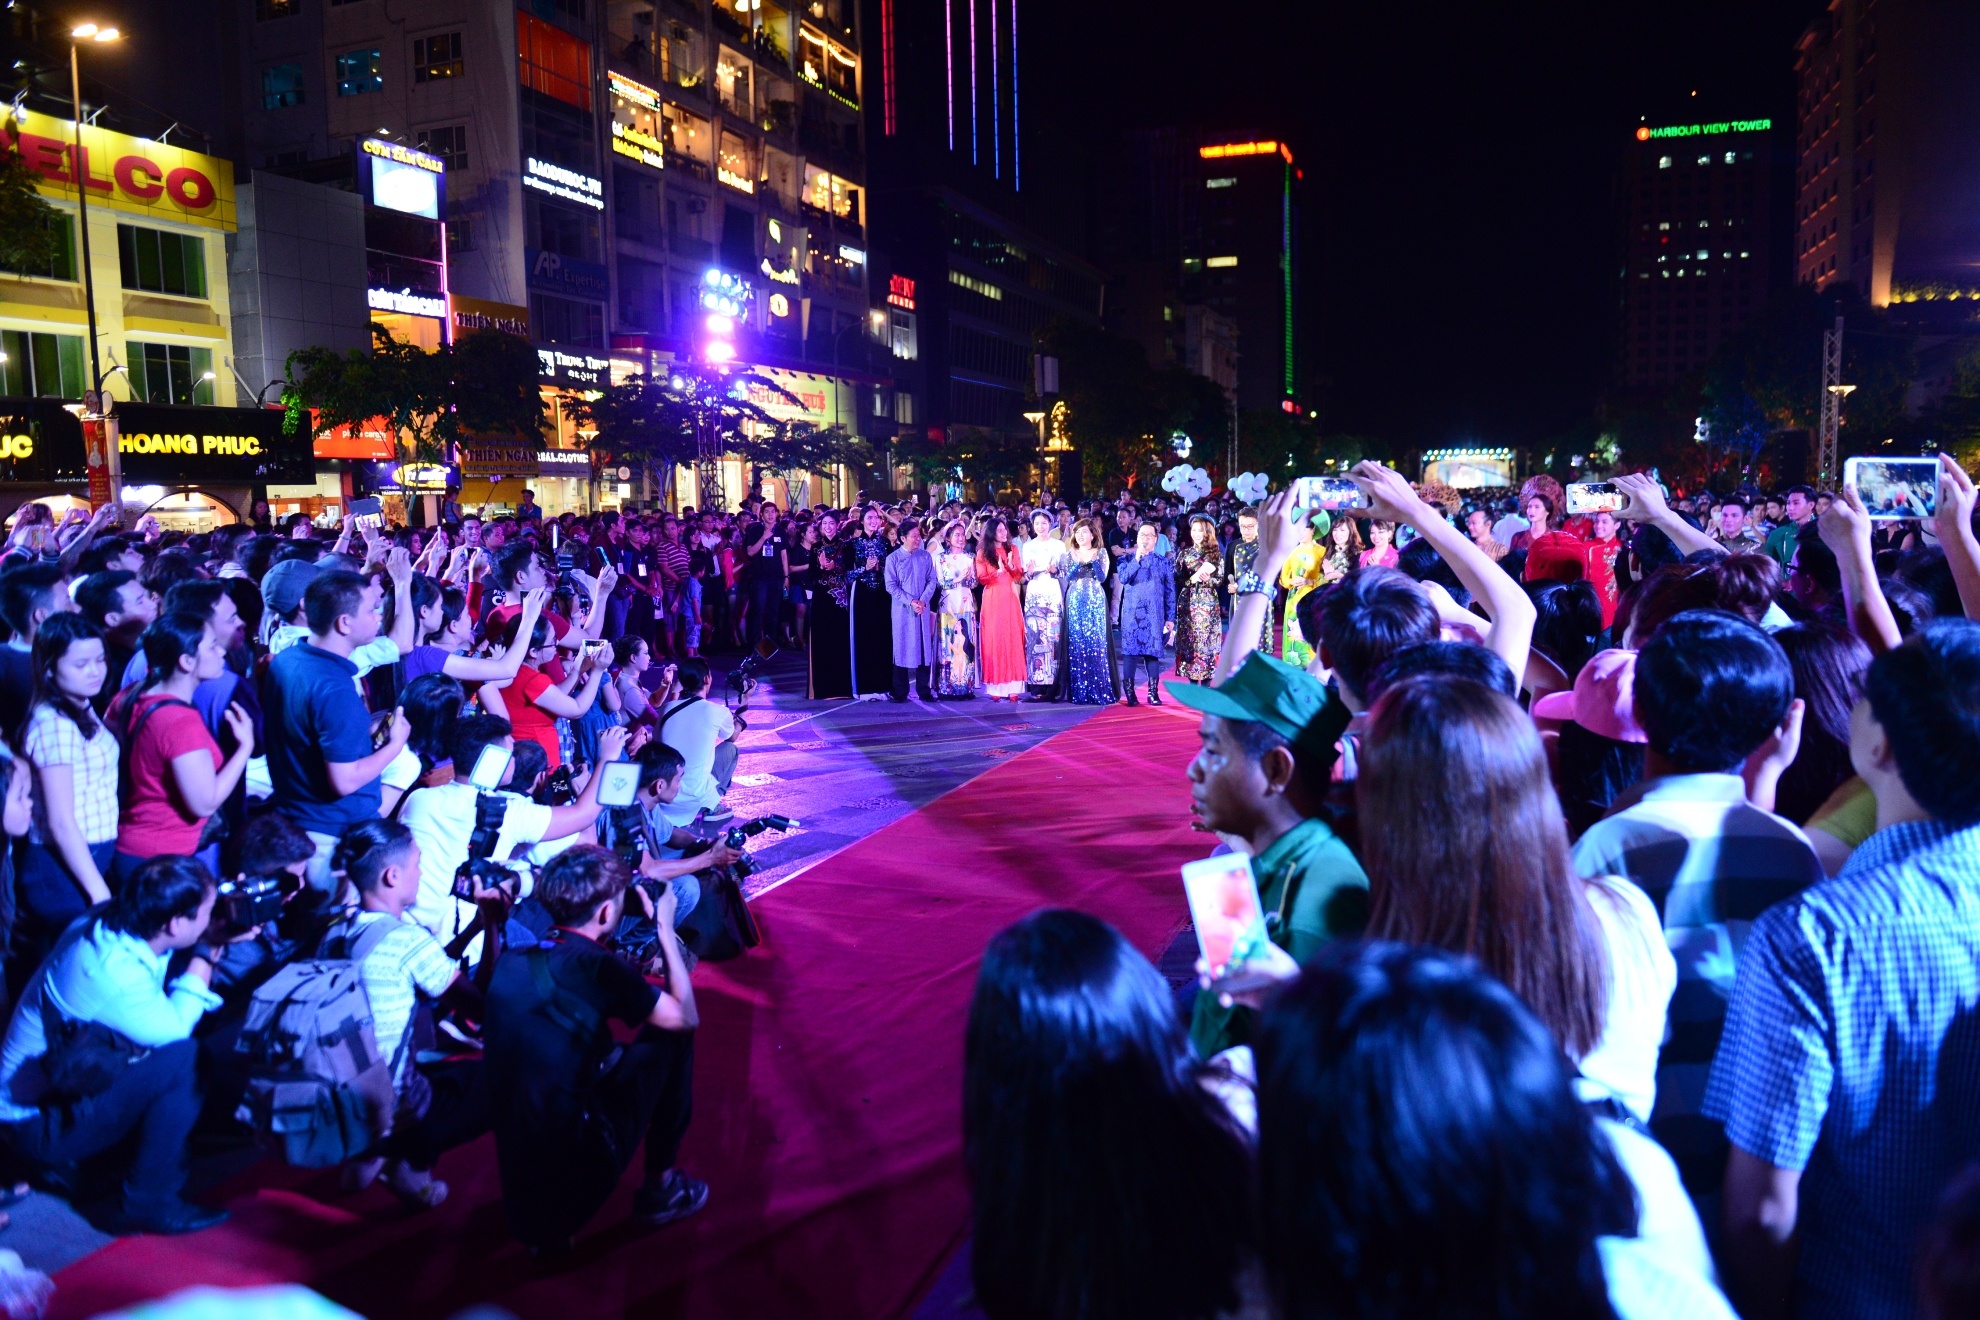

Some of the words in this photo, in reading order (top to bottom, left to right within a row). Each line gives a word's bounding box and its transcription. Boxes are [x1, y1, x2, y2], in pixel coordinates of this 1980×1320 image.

[1649, 124, 1700, 138] HARBOUR
[1702, 122, 1730, 134] VIEW
[1731, 119, 1771, 132] TOWER
[0, 129, 215, 208] ELCO
[118, 433, 197, 454] HOANG
[202, 434, 260, 455] PHUC
